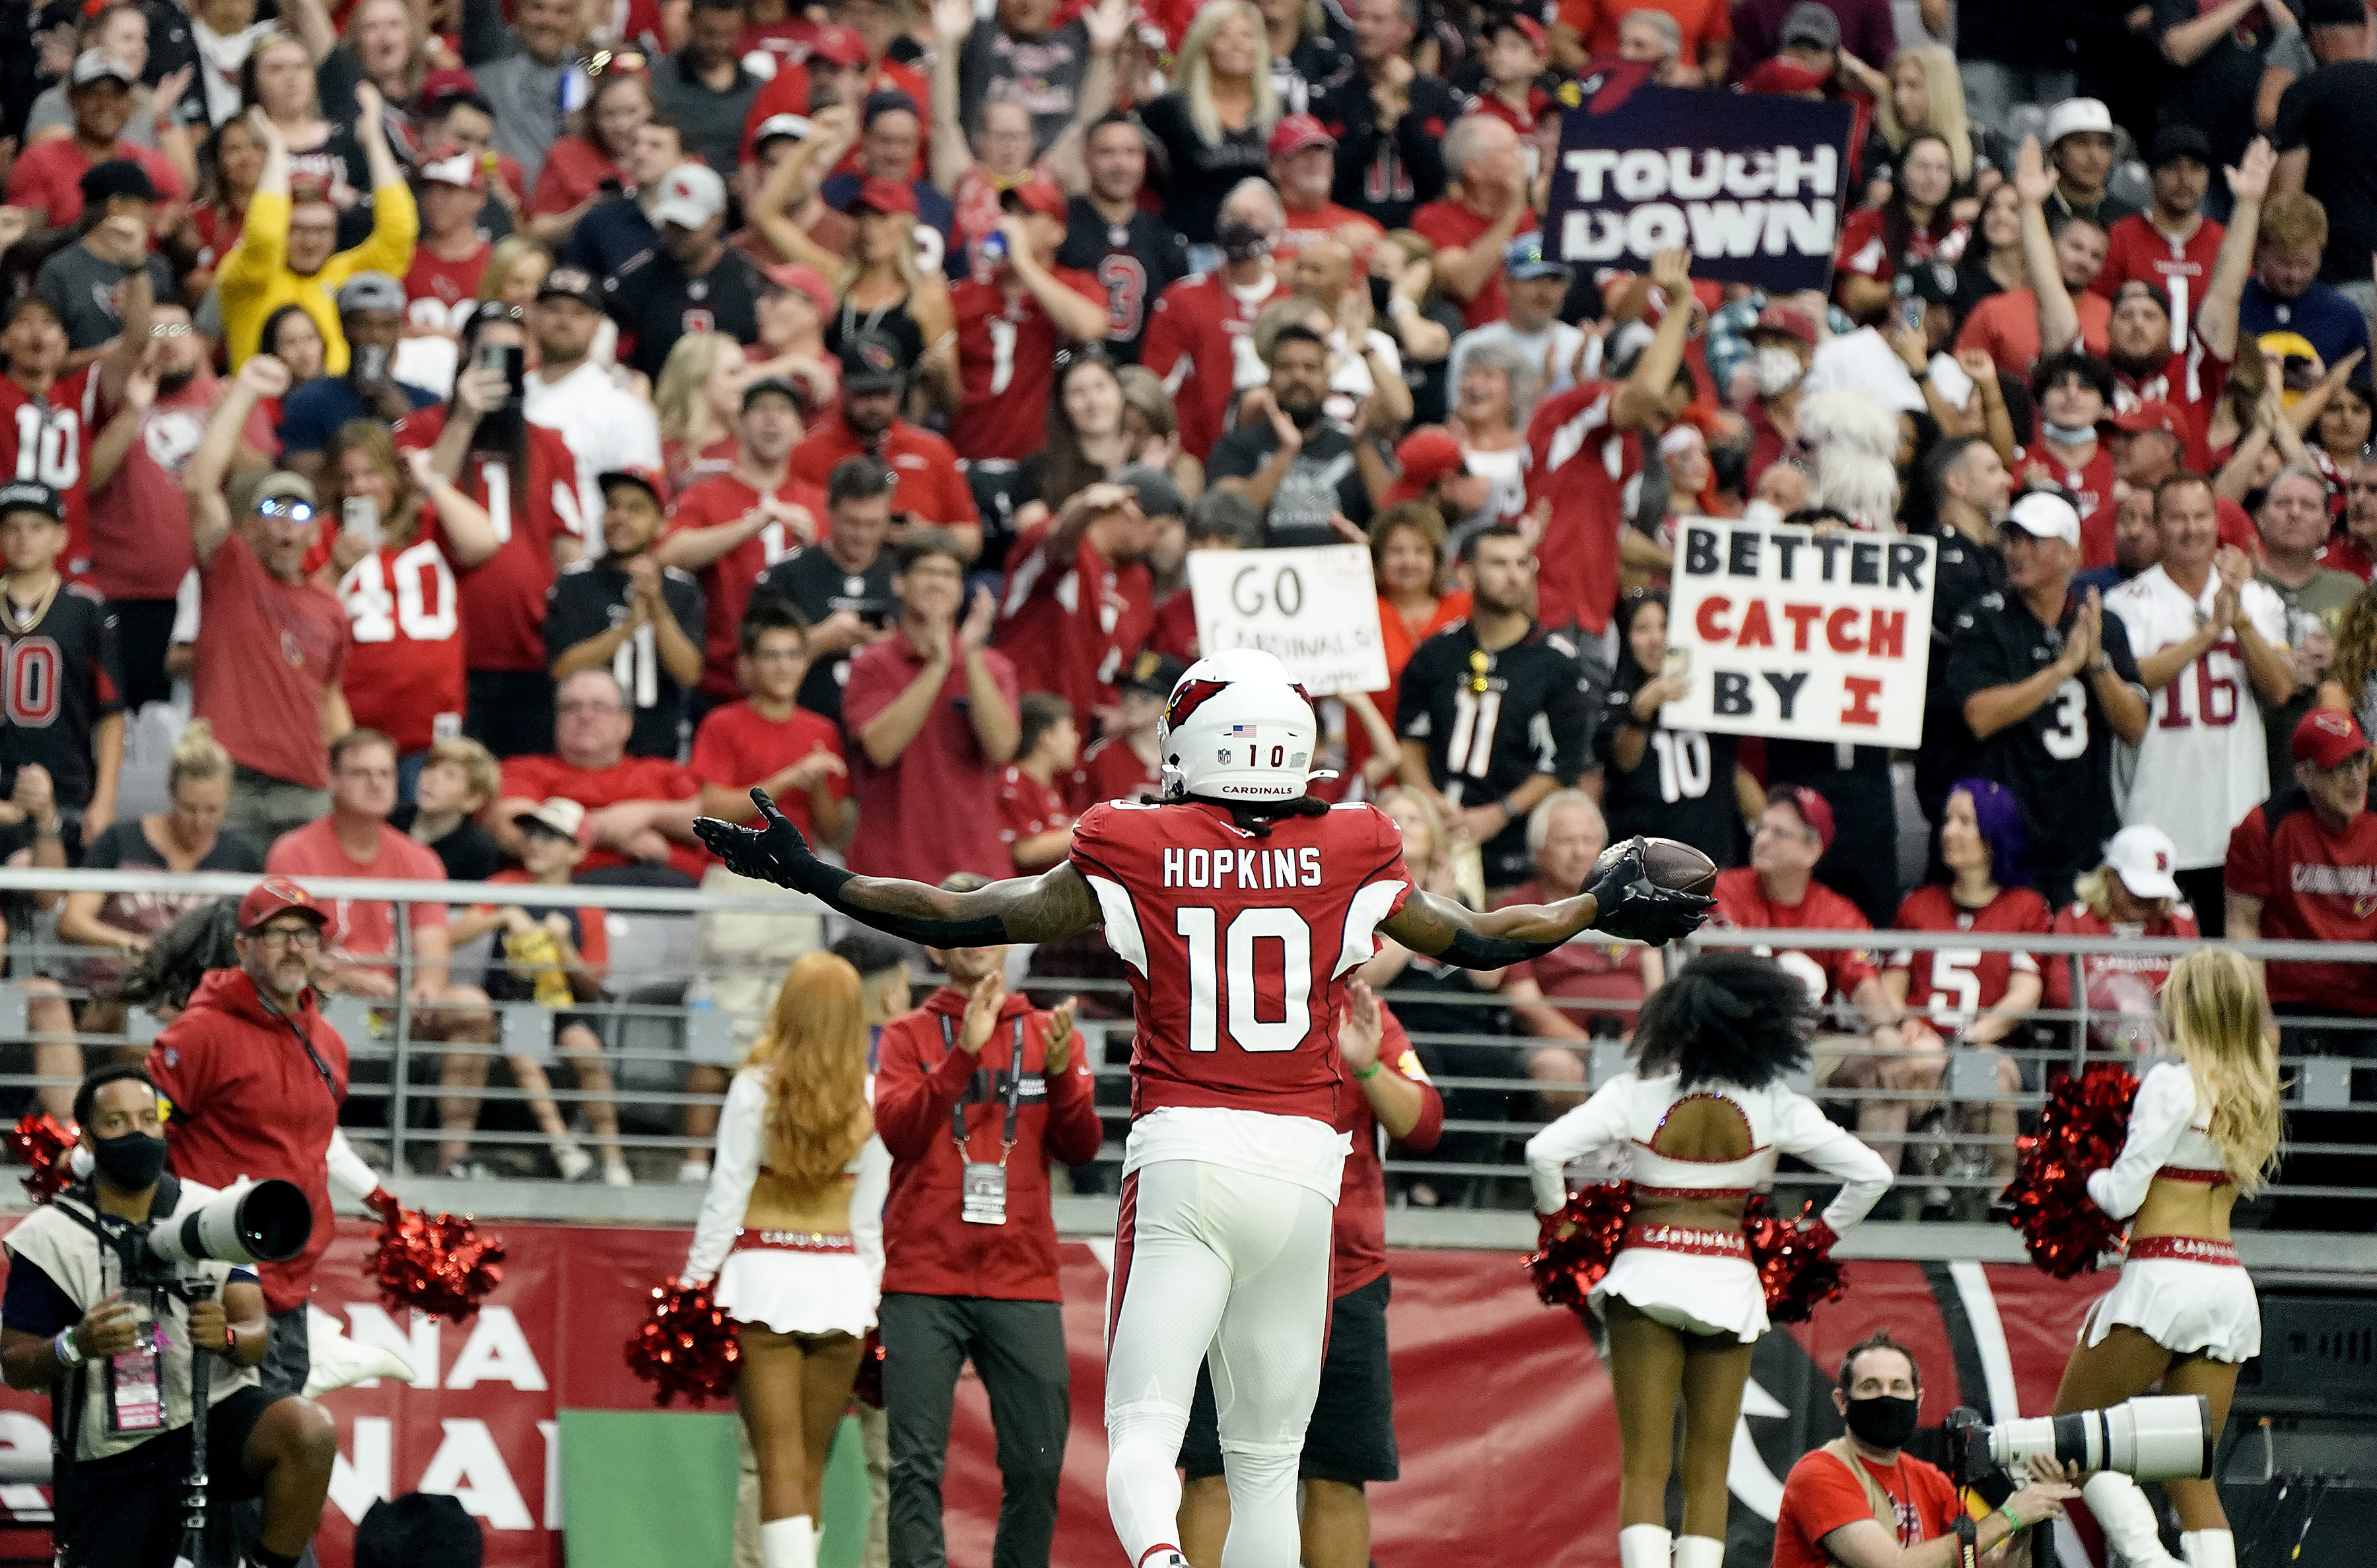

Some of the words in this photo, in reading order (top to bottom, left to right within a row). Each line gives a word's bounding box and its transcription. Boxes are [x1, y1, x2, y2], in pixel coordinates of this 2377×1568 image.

[1564, 143, 1839, 201] TOUCH
[1561, 199, 1836, 261] DOWN
[15, 403, 80, 490] 10
[336, 539, 458, 642] 40
[1231, 564, 1303, 618] GO
[1686, 528, 1928, 593] BETTER
[1696, 596, 1906, 659] CATCH
[1714, 671, 1809, 720] BY
[1840, 676, 1882, 725] I
[2043, 676, 2089, 759] 3
[2157, 642, 2240, 728] 16
[1447, 687, 1501, 778] 11
[1222, 786, 1292, 794] CARDINALS
[1651, 731, 1711, 803] 10
[1163, 847, 1321, 889] HOPKINS
[1176, 906, 1312, 1052] 10
[1928, 947, 1981, 1026] 5
